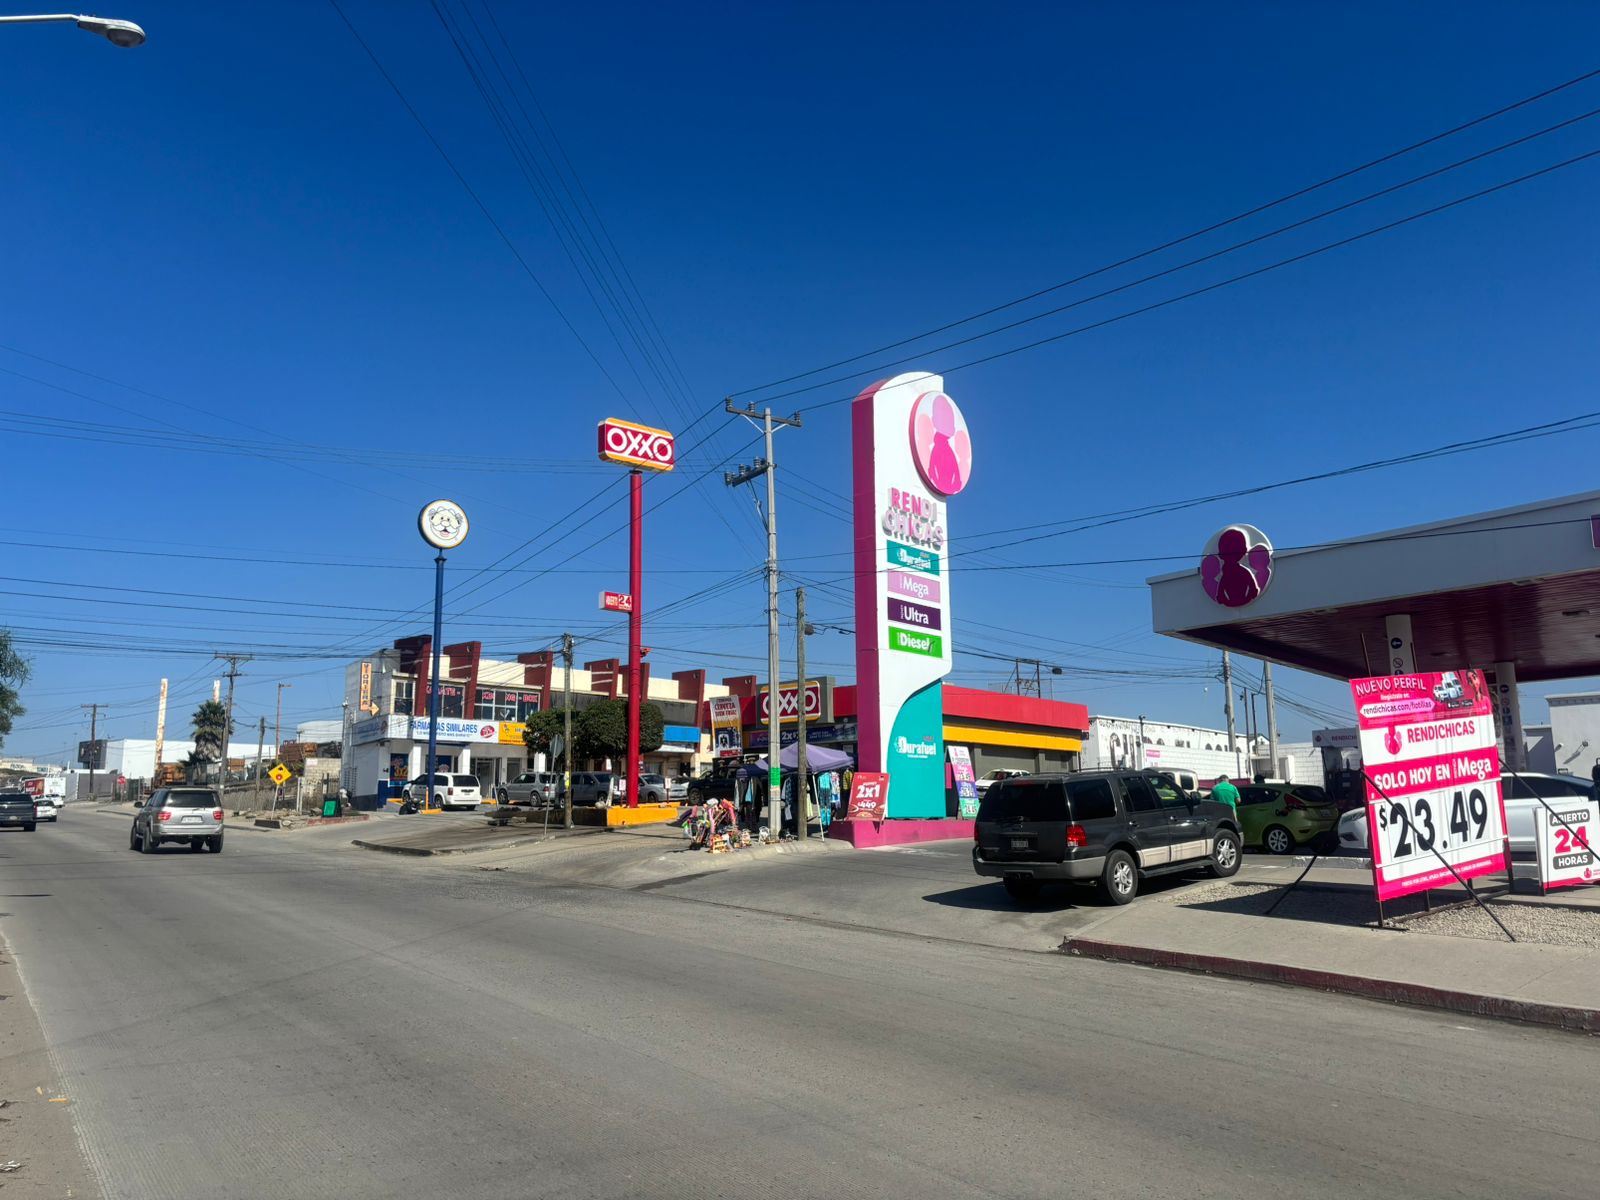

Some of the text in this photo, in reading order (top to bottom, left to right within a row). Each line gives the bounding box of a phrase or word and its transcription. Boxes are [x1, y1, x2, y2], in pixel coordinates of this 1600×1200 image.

[607, 427, 672, 462] OXXO
[889, 487, 938, 521] RENDI
[903, 576, 929, 599] Mega
[903, 605, 929, 625] Ultra
[900, 632, 931, 651] Diesel
[1355, 677, 1427, 696] NUEVO PERFIL
[410, 720, 445, 733] FARMAAS
[1407, 720, 1475, 743] RENDICHICAS
[1374, 771, 1407, 790] SOLO
[1409, 765, 1433, 785] HOY
[1435, 763, 1450, 779] EN
[1457, 757, 1492, 780] Mega
[856, 784, 880, 798] 2x1
[1554, 826, 1589, 854] 24
[1558, 855, 1589, 867] HORAS
